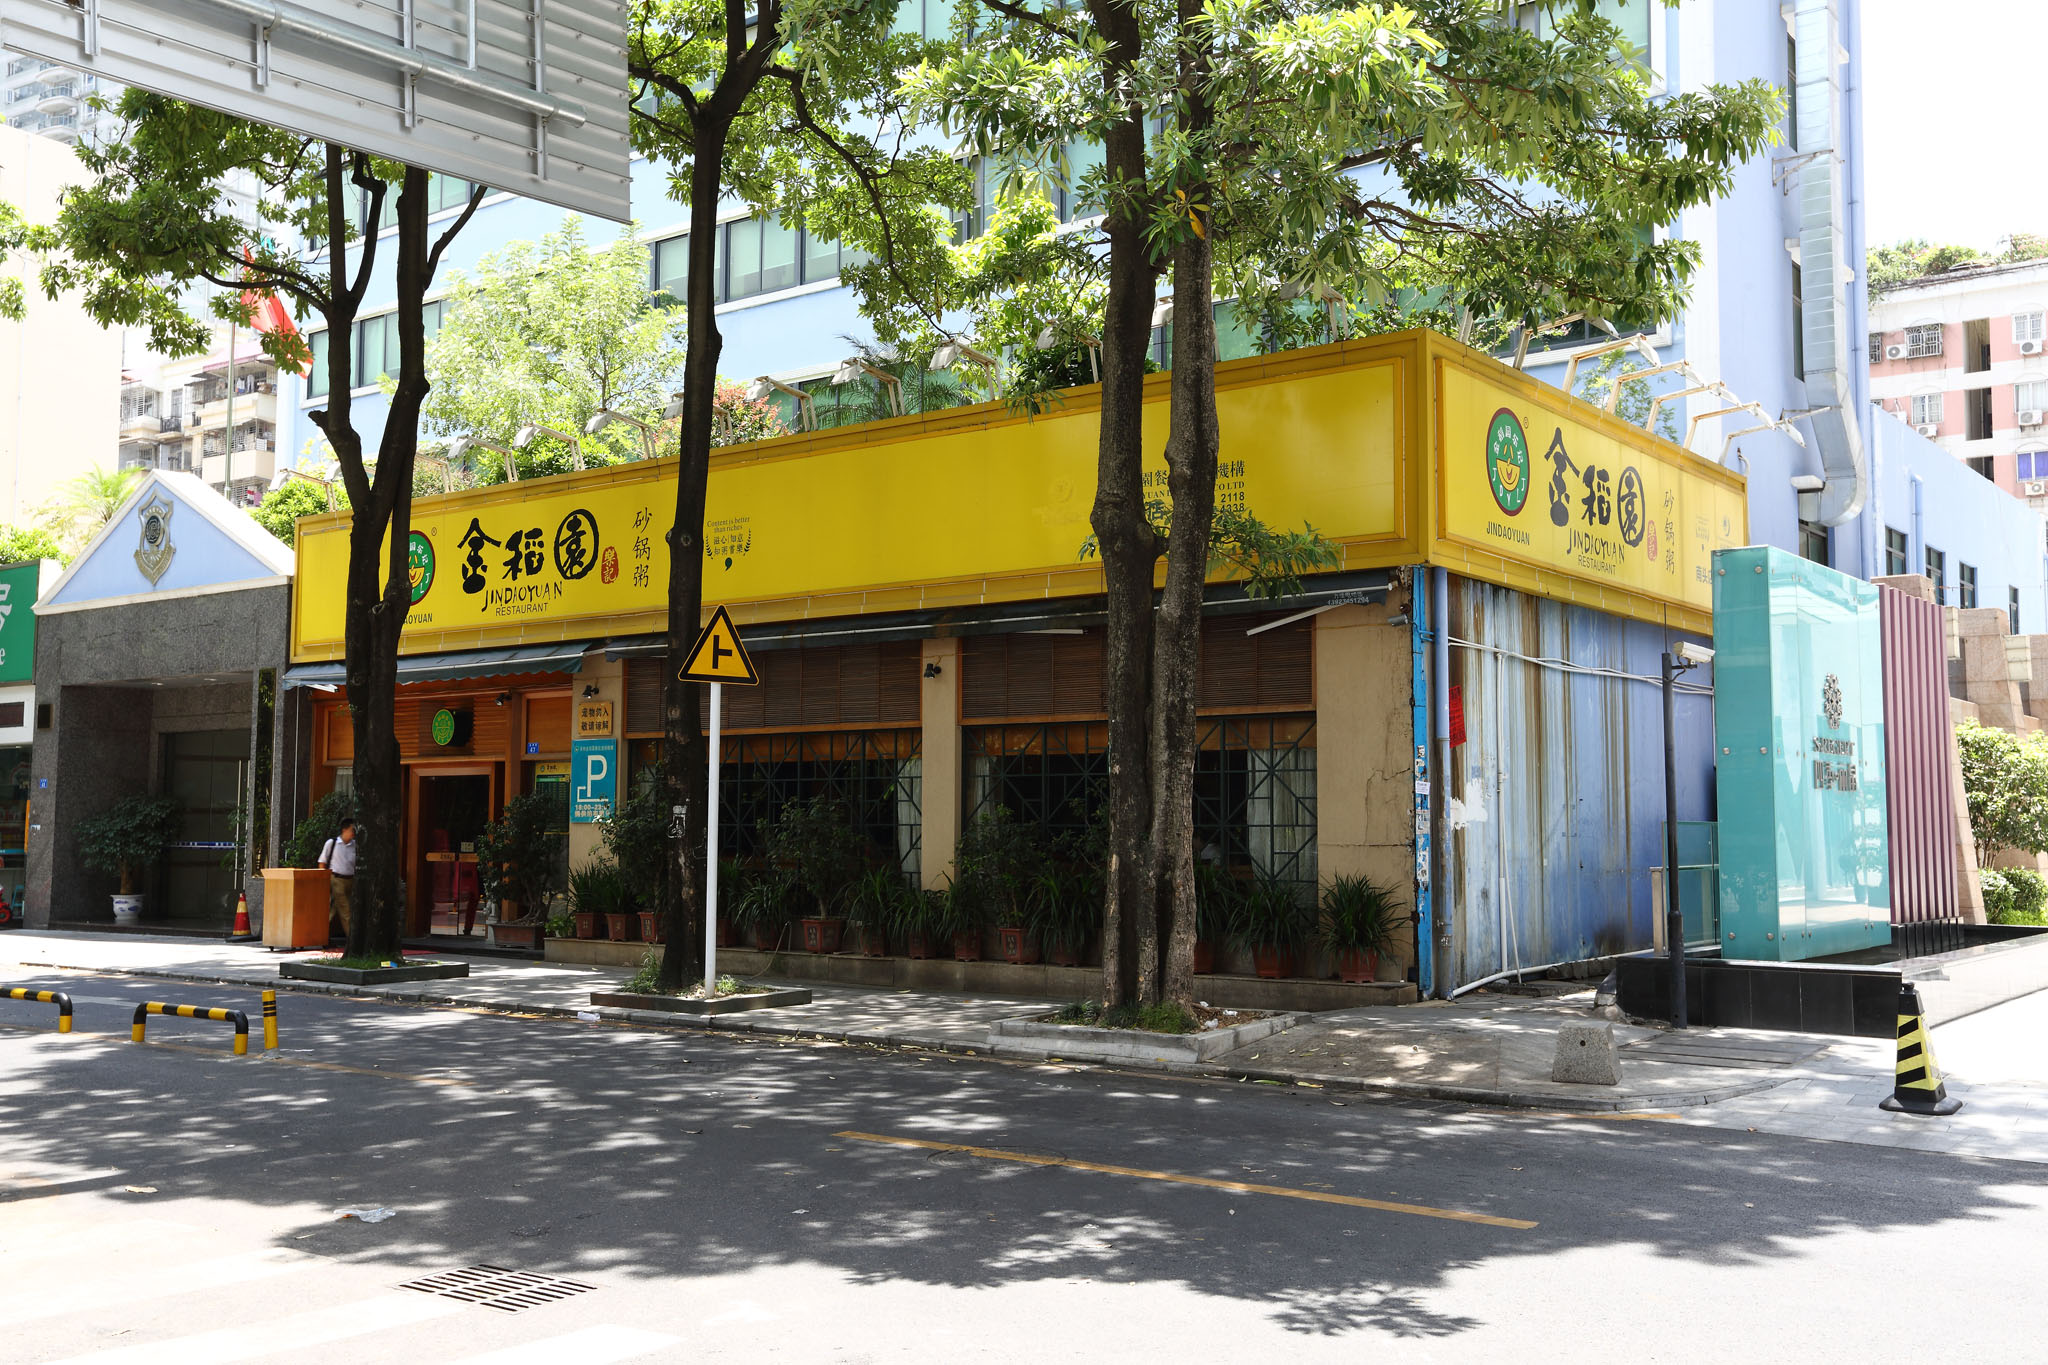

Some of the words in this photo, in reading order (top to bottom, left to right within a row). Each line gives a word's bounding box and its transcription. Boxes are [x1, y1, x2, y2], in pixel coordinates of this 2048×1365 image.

[1221, 492, 1245, 503] 2118
[1227, 481, 1245, 491] LTD
[1486, 520, 1530, 546] JINDAOYUAN
[1566, 527, 1625, 565] JINDAOYUAN
[632, 507, 652, 589] 砂锅粥
[1577, 554, 1616, 575] RESTAURANT
[481, 580, 563, 613] JINDAOYUAN
[495, 603, 549, 617] RESTAURANT
[586, 754, 608, 798] P
